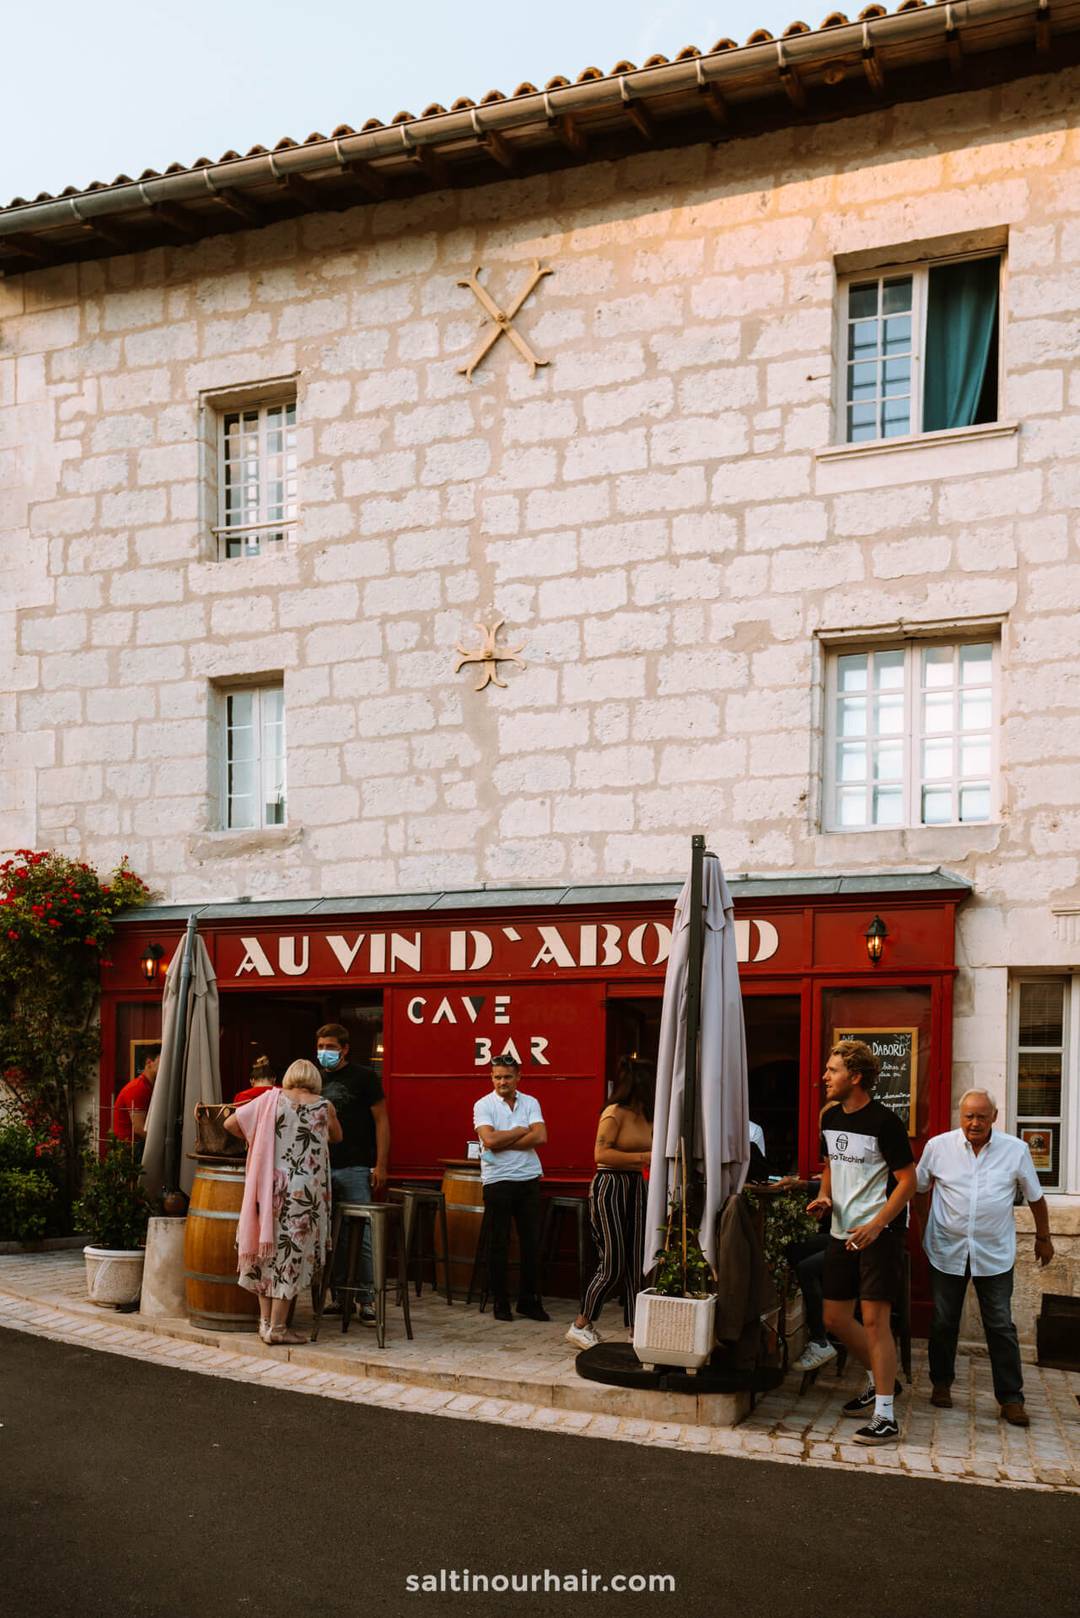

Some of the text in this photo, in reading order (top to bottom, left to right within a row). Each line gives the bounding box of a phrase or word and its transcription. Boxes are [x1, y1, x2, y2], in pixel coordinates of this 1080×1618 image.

[234, 919, 779, 977] AU VIN D'ABOD
[407, 995, 511, 1024] CAVE
[474, 1036, 550, 1065] BAR
